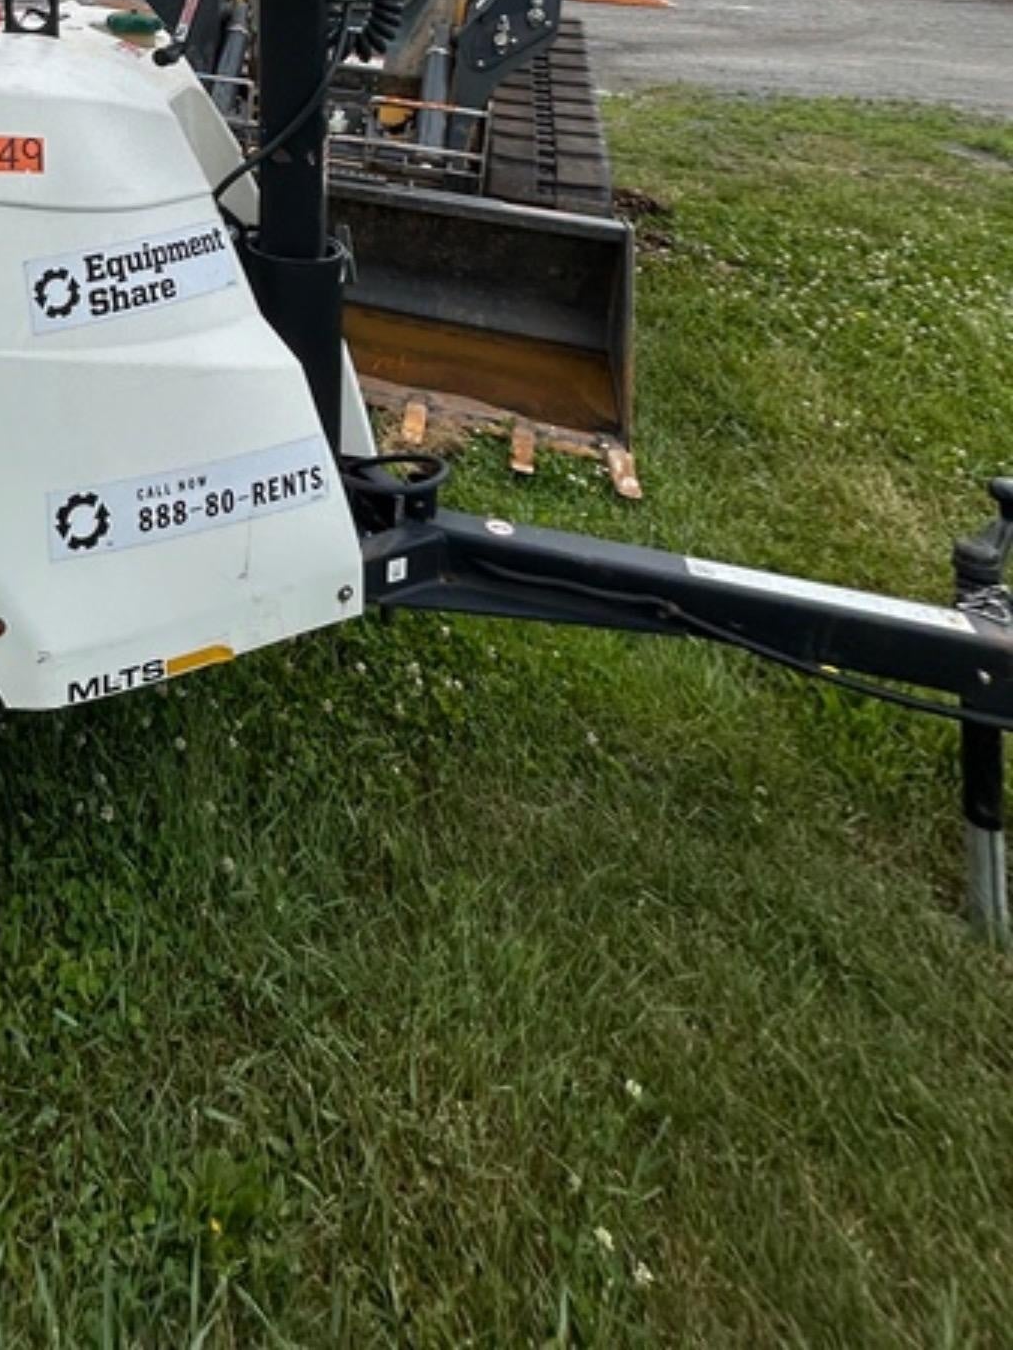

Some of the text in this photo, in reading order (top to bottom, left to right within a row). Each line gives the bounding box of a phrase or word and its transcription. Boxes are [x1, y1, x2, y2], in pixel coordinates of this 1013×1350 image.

[83, 227, 225, 282] Equipment
[89, 276, 177, 316] Share
[137, 476, 207, 500] CALL NOW
[138, 464, 324, 532] 888-80-RENTS
[67, 658, 165, 703] MLTS
